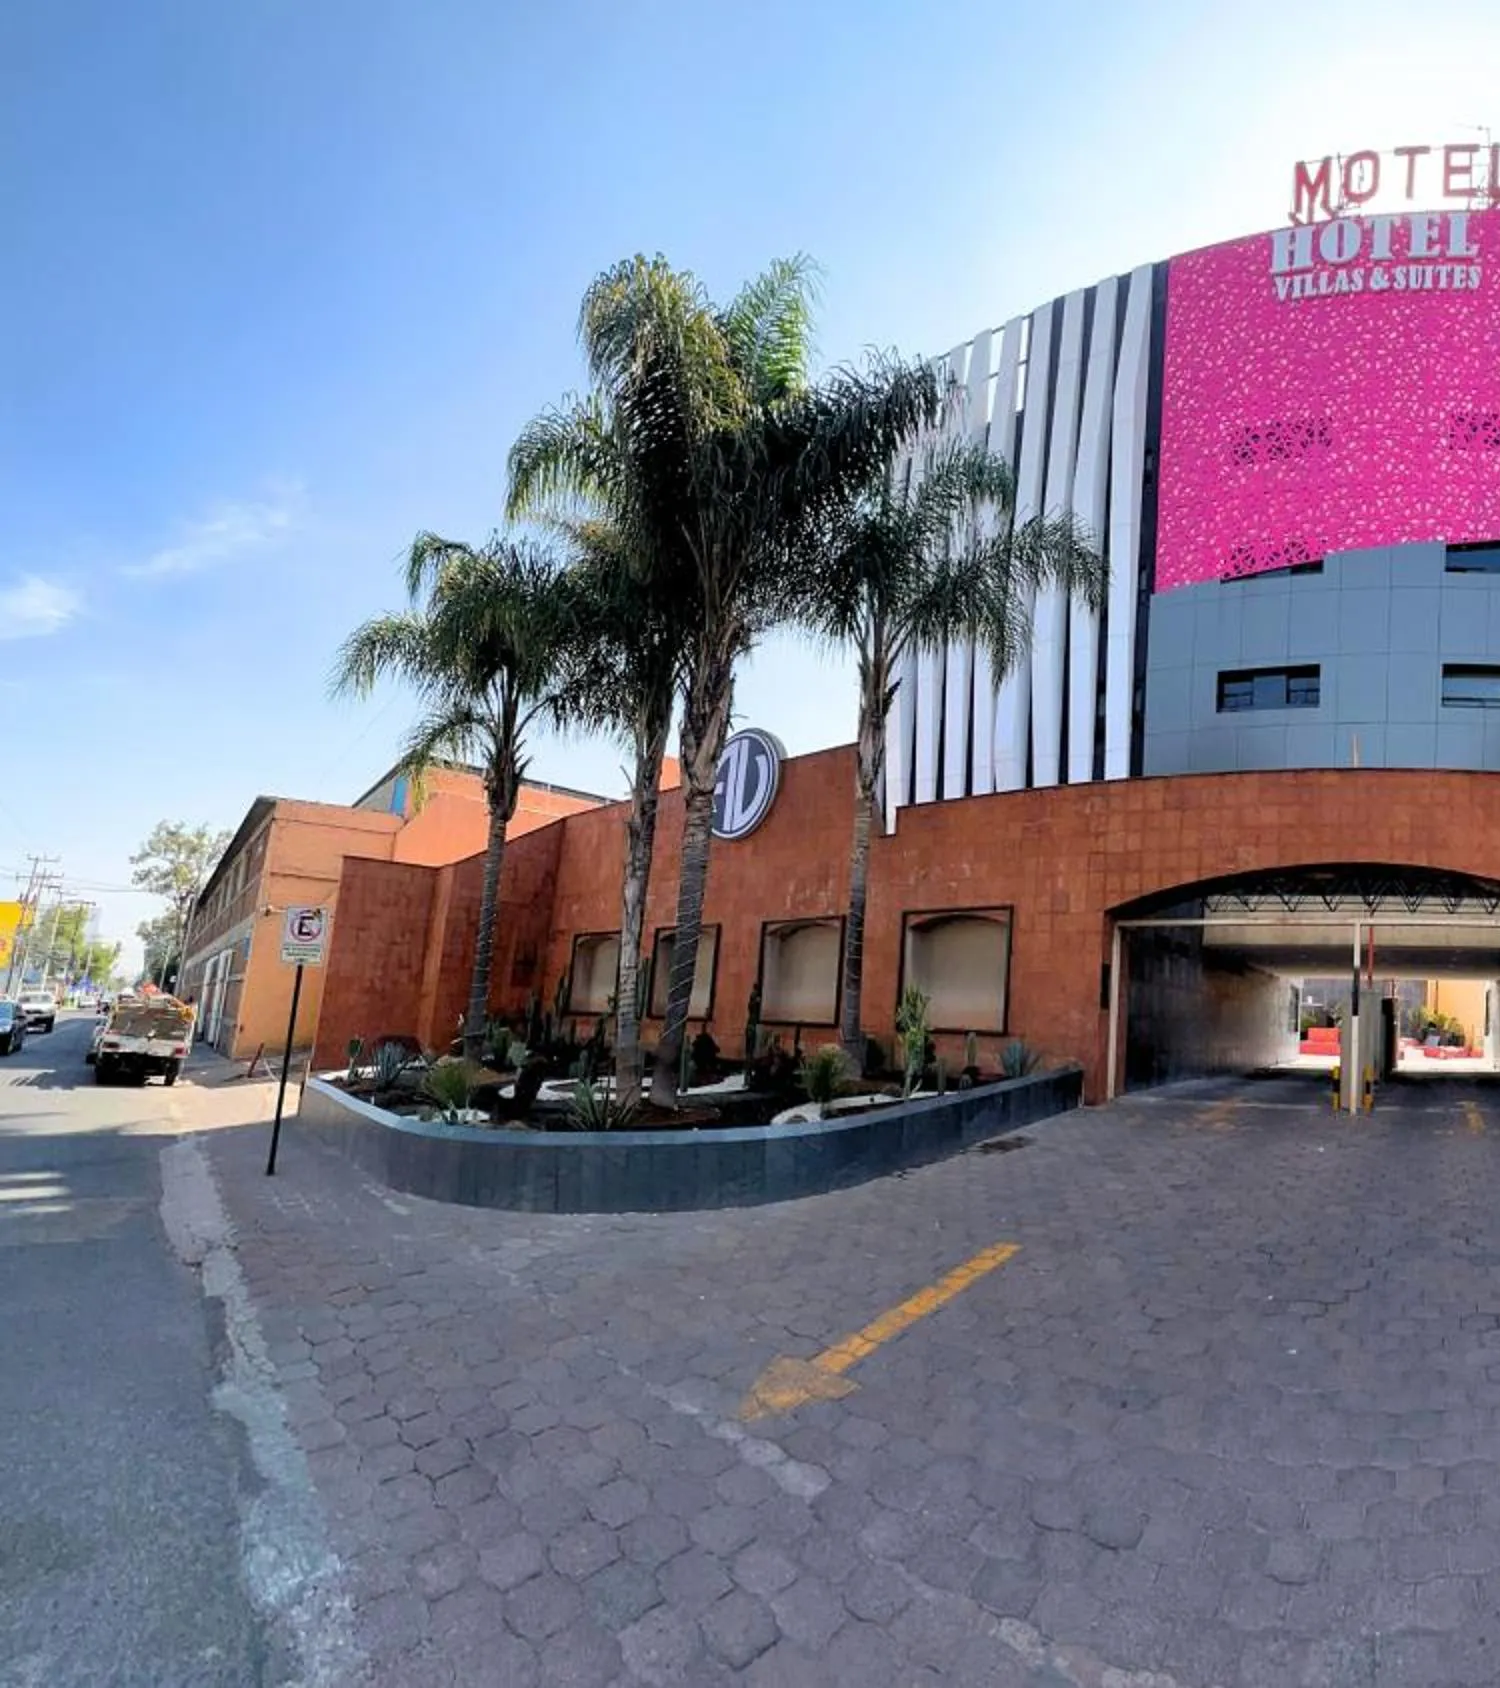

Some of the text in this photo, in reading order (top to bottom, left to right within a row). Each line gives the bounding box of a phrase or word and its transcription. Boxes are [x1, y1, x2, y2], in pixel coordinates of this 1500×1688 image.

[1271, 212, 1479, 273] HOTEL
[1274, 264, 1482, 301] VILLAS & SUITES
